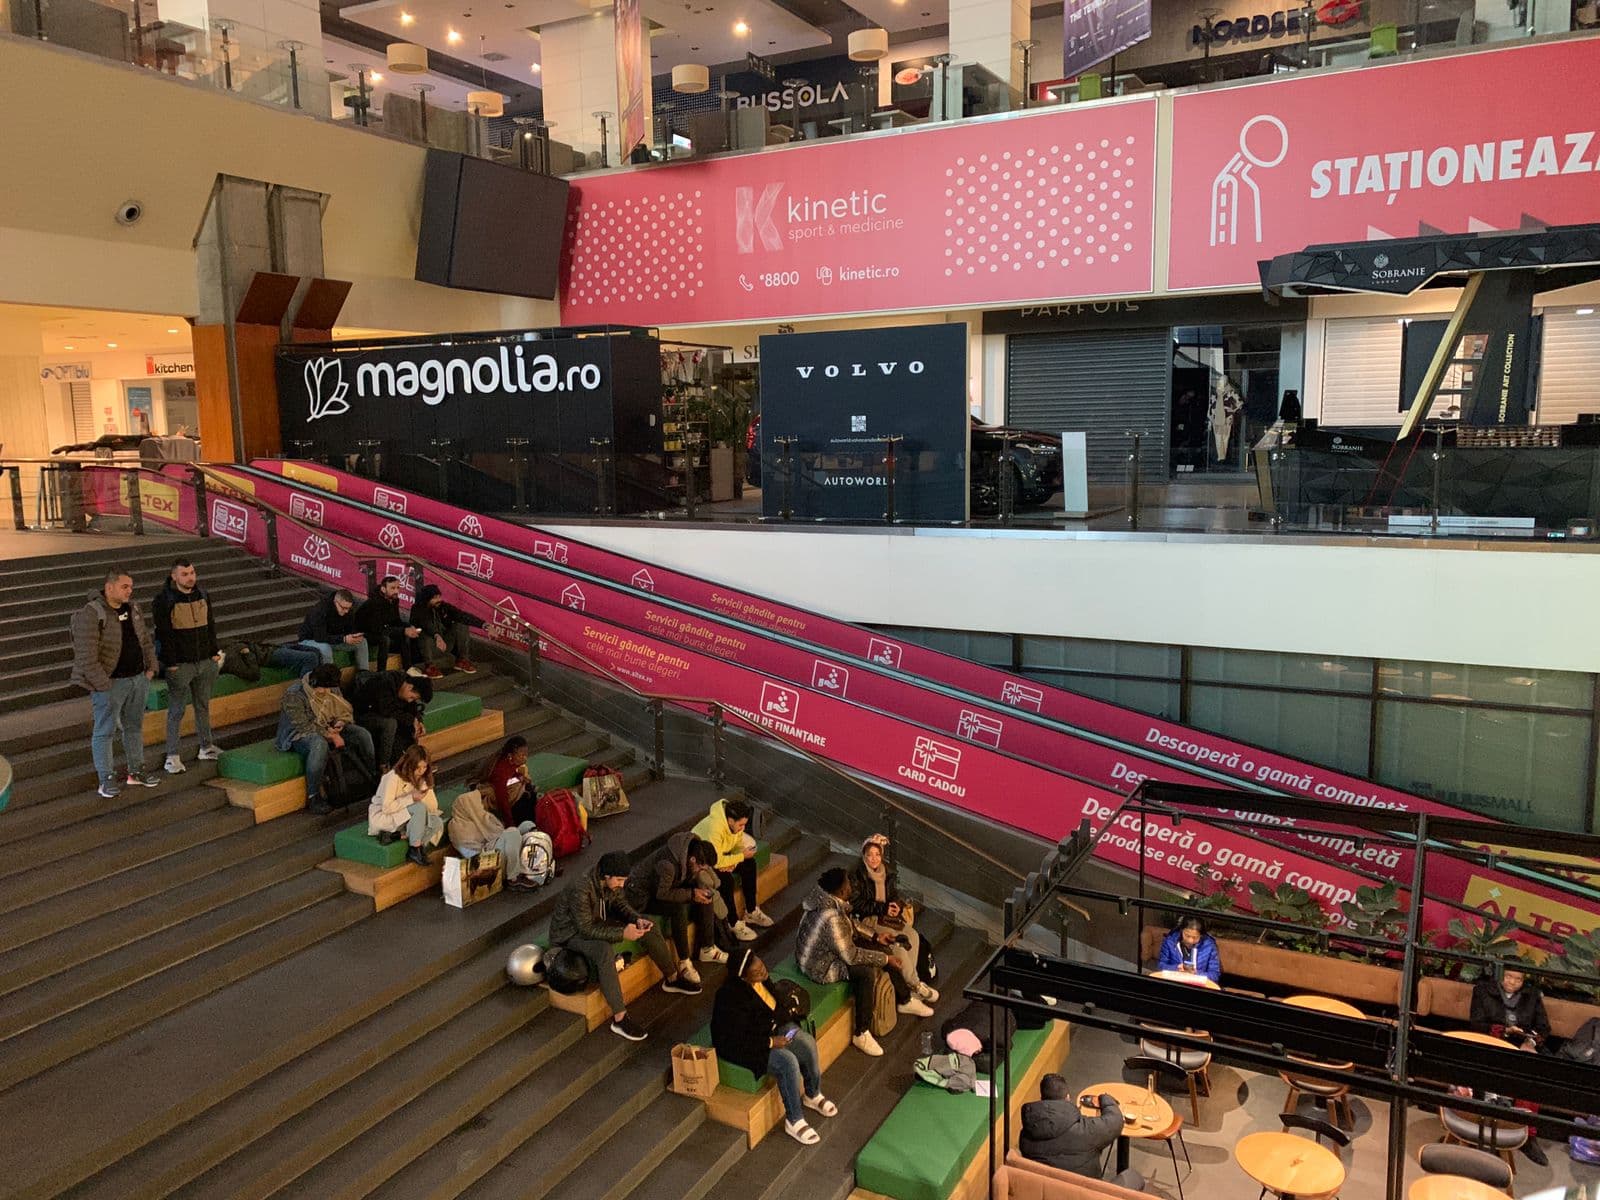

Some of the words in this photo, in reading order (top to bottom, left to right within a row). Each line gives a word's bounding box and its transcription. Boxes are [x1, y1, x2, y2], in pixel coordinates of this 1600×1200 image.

[1310, 131, 1600, 205] STAȚIONEAZ
[787, 189, 887, 223] kinetic
[788, 225, 824, 242] sport
[827, 224, 835, 235] &
[840, 216, 904, 234] medicine
[839, 264, 899, 281] kinetic.ro
[1371, 267, 1426, 279] SOBRANIE
[1504, 333, 1515, 374] COLLECTION
[154, 361, 193, 374] kitchen
[357, 345, 601, 405] magnolia.ro
[796, 360, 924, 378] VOLVO
[824, 476, 895, 486] AUTOWORL
[228, 514, 244, 530] X2
[644, 610, 679, 628] Servicii
[714, 635, 747, 651] pentru
[776, 615, 806, 630] pentru
[583, 626, 619, 645] Servicii
[620, 639, 657, 658] gândite
[656, 653, 690, 670] pentru
[586, 641, 604, 654] cele
[605, 647, 623, 659] mai
[624, 652, 647, 668] bune
[761, 716, 774, 729] DE
[1145, 728, 1241, 769] Descoperă
[1242, 760, 1255, 773] o
[1255, 765, 1314, 790] gamă
[898, 765, 926, 783] CARD
[928, 776, 966, 797] CADOU
[1197, 841, 1212, 855] o
[1214, 848, 1284, 880] gamă
